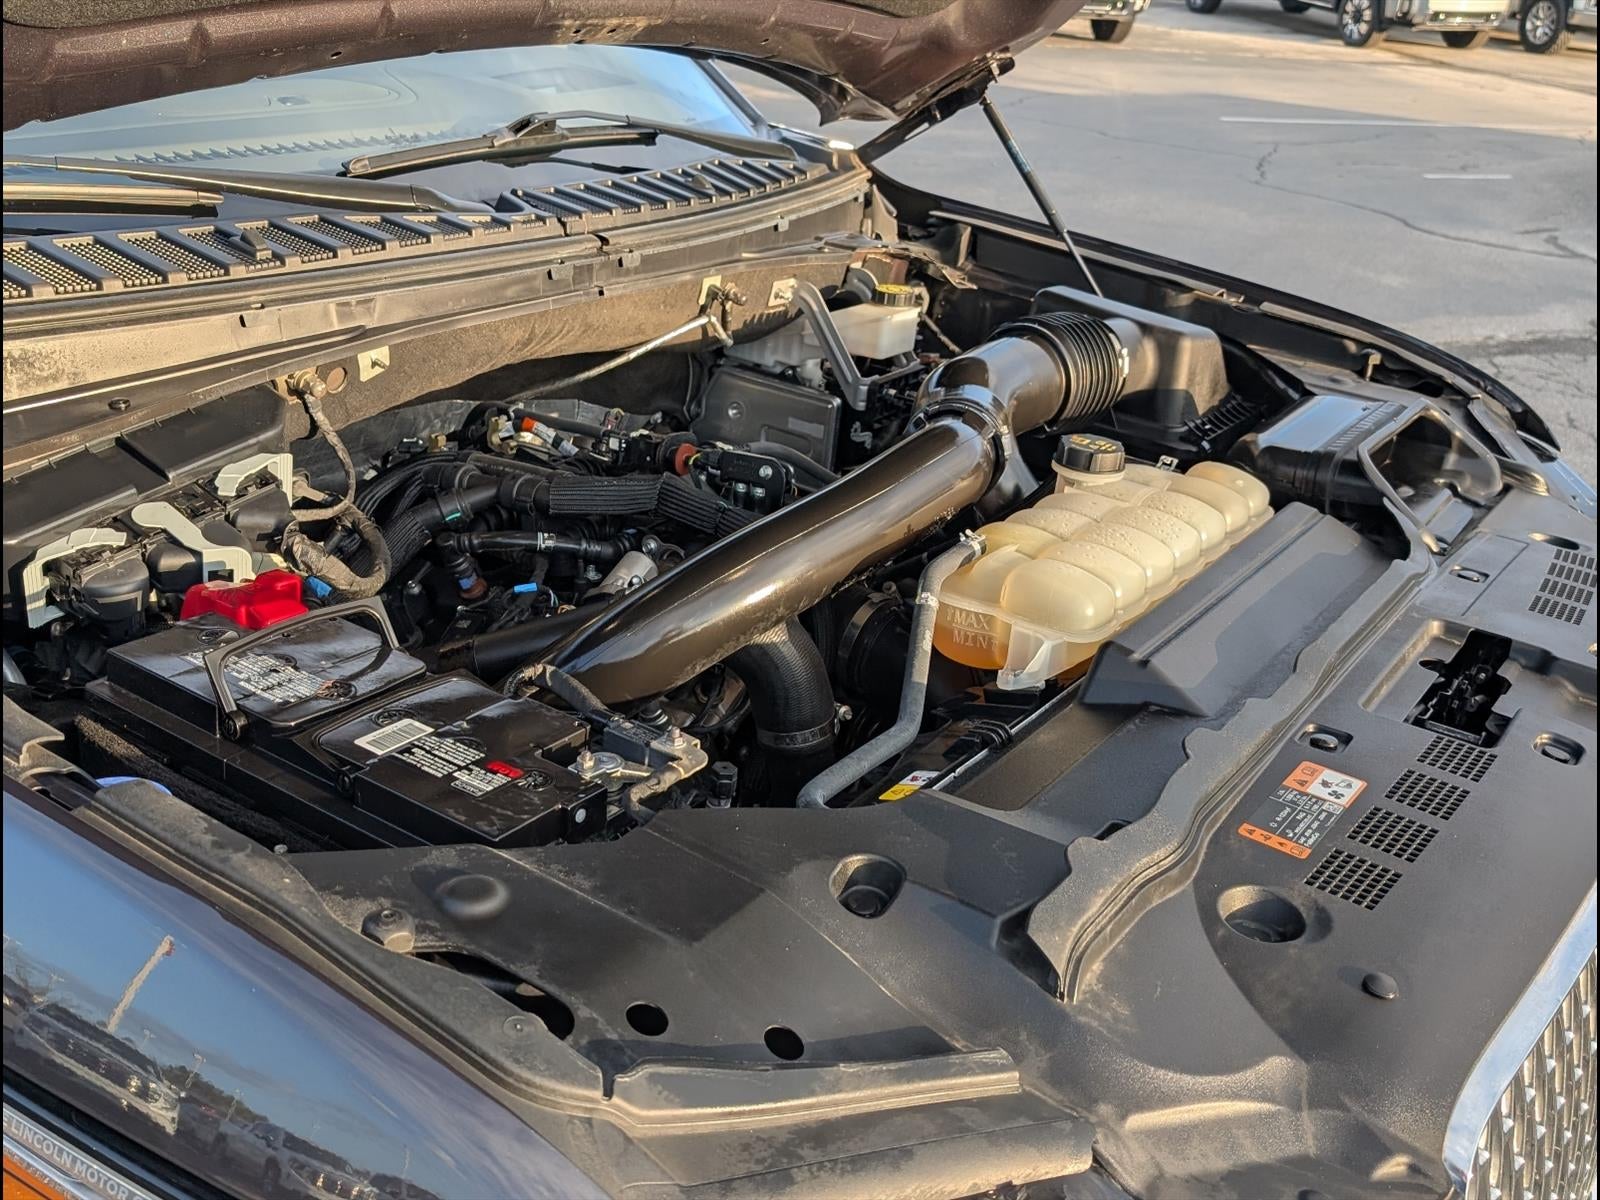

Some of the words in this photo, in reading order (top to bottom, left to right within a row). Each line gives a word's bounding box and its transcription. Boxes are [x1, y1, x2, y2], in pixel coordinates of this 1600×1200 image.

[953, 608, 991, 630] MAX
[952, 629, 988, 649] MIN
[11, 1118, 74, 1168] LINCOLN
[73, 1158, 129, 1200] MOTOR
